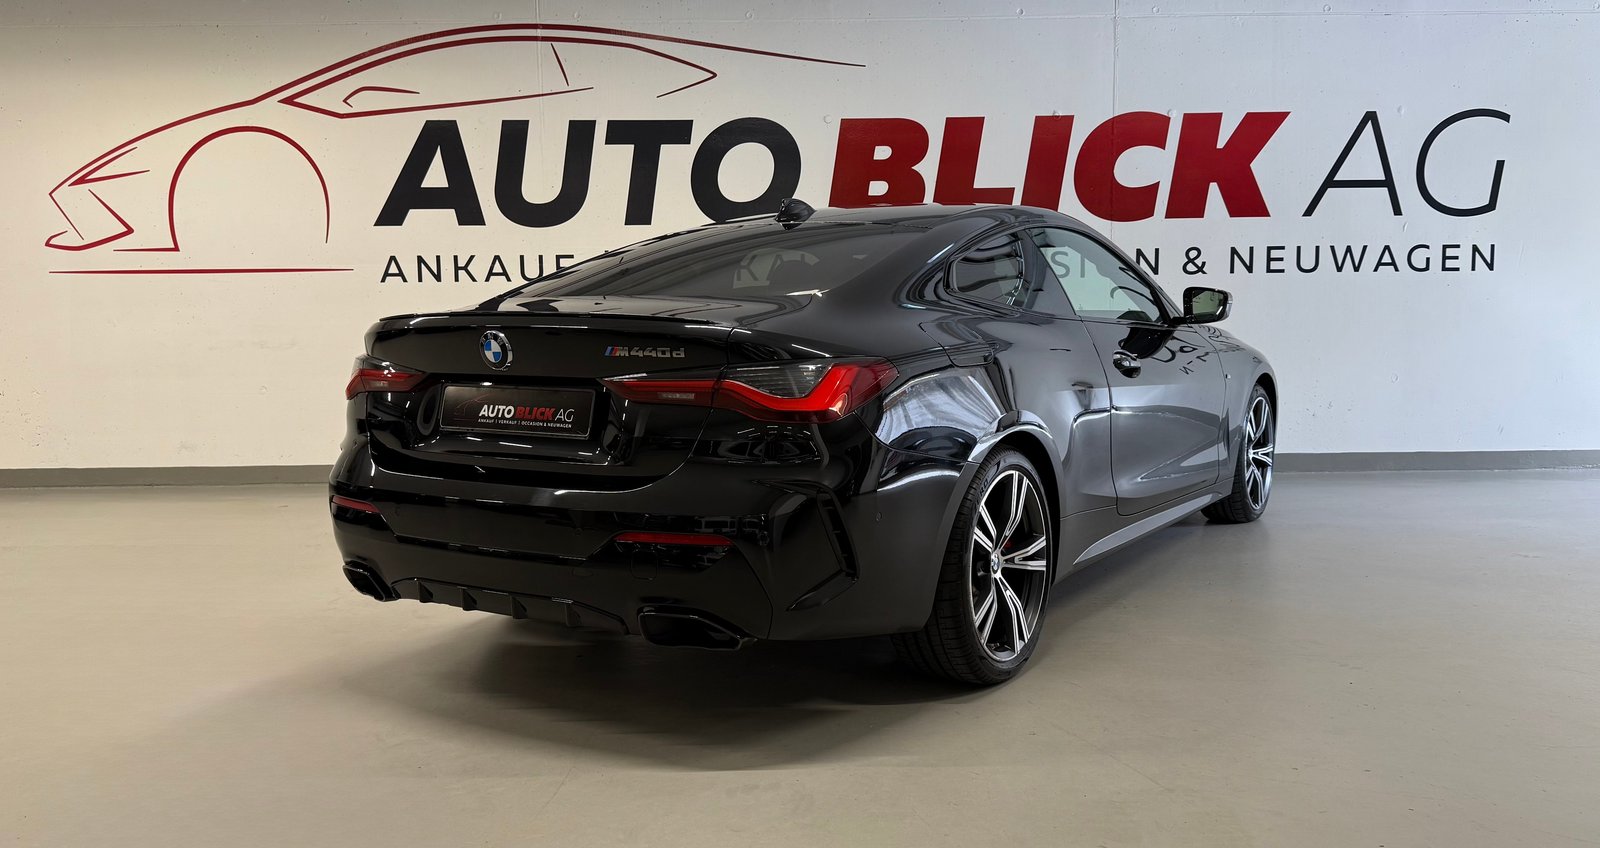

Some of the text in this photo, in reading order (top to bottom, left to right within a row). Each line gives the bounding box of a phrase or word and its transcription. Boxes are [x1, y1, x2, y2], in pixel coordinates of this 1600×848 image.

[374, 109, 1510, 227] AUTO BLICK AG
[1183, 247, 1208, 275] &
[1230, 244, 1495, 274] NEUWAGEN
[479, 404, 575, 422] AUTO BLICK AG
